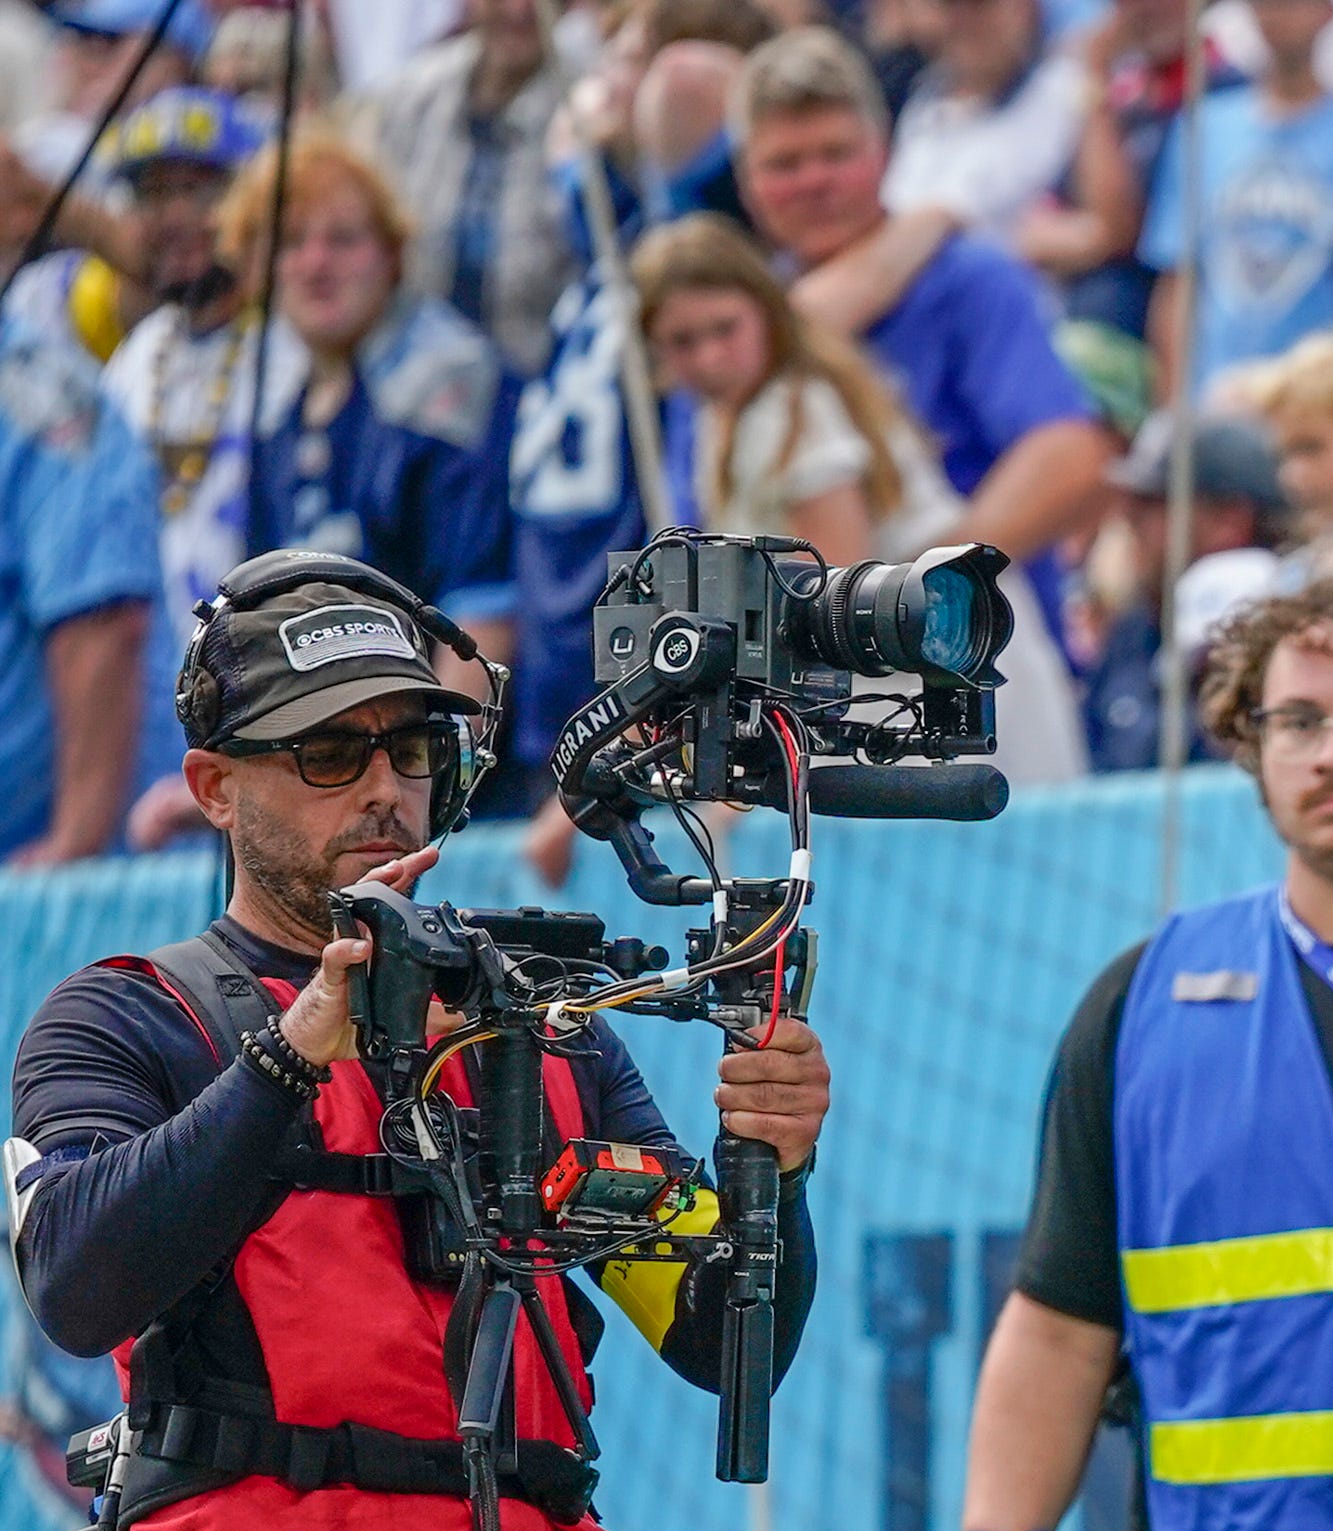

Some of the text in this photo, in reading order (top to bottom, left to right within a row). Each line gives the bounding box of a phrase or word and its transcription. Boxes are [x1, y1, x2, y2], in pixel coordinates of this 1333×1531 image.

[311, 622, 400, 642] CBS SPORTS
[667, 639, 689, 661] CBS
[551, 695, 620, 784] LIGRANI
